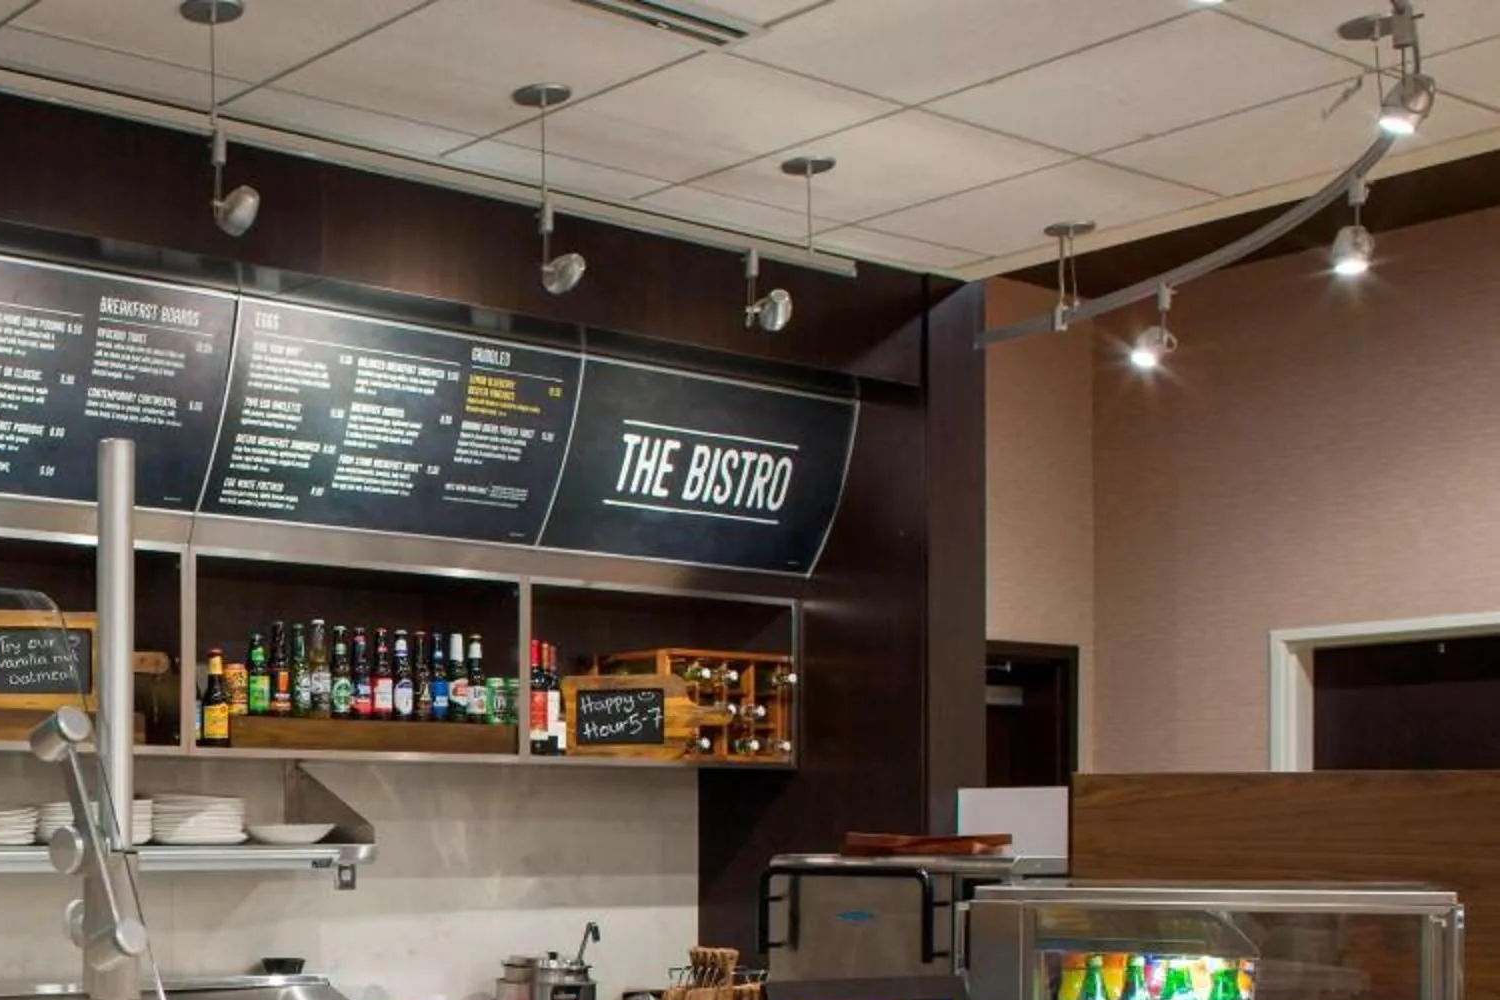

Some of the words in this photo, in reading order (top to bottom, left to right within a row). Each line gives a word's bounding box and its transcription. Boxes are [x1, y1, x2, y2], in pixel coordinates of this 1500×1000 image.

[100, 296, 157, 321] BREAKFAST
[161, 306, 200, 328] BOARDS
[616, 433, 681, 497] THE
[681, 444, 793, 511] BISTRO
[27, 638, 56, 650] our
[580, 694, 636, 715] Happy
